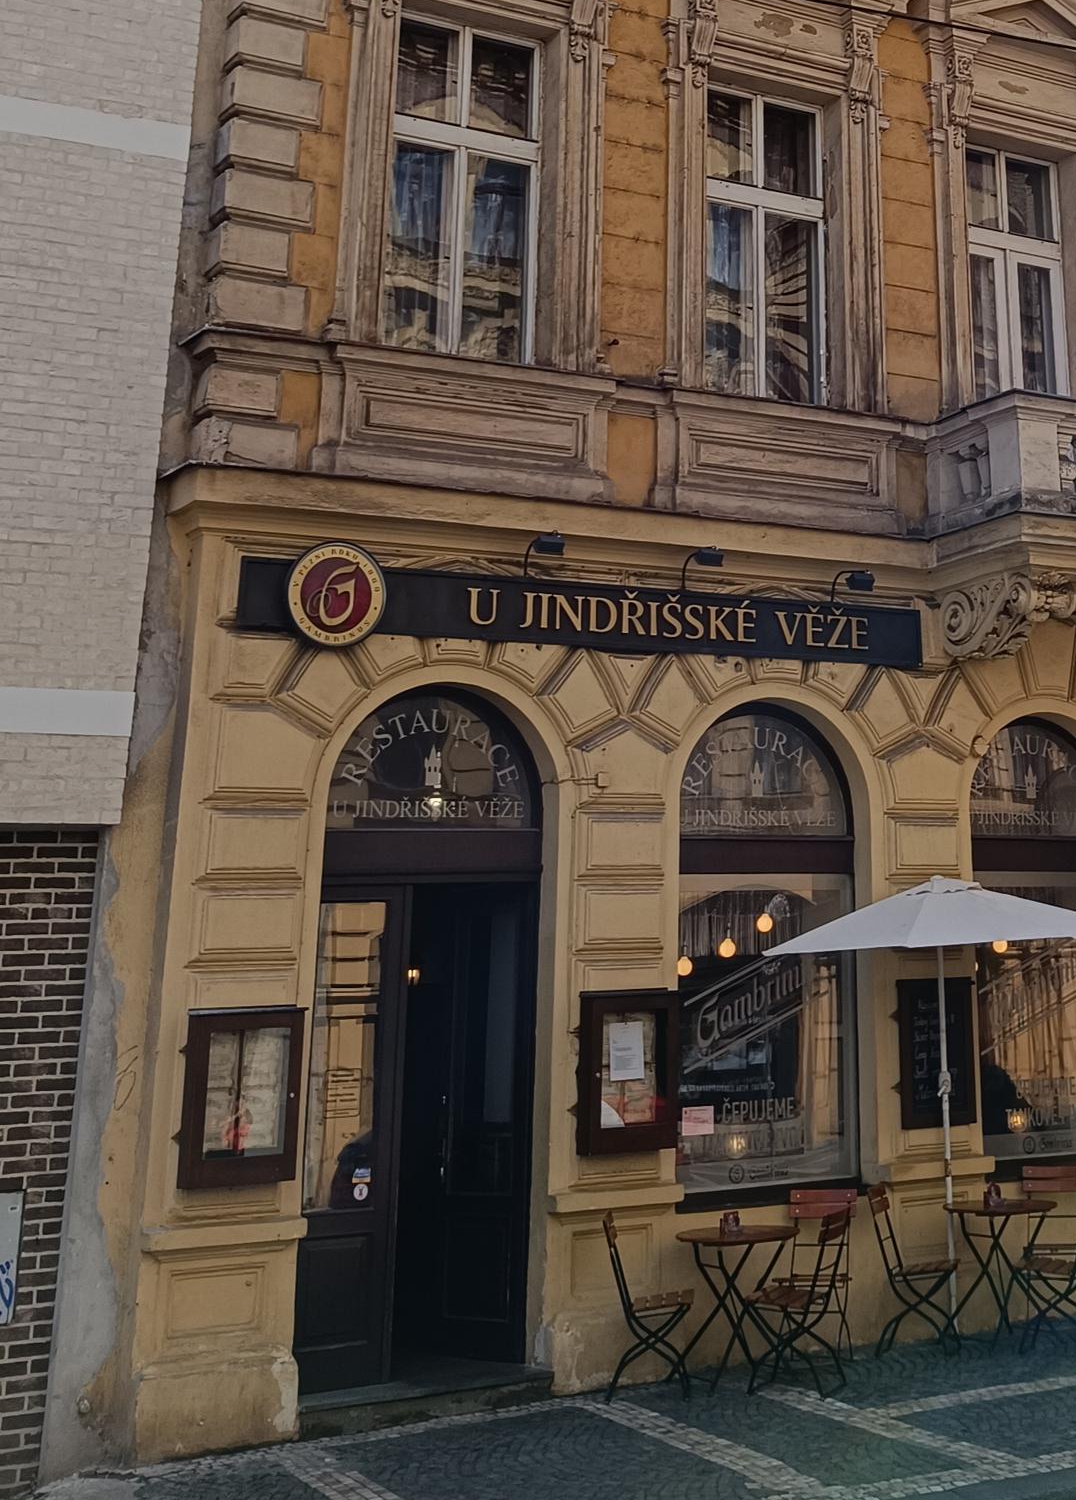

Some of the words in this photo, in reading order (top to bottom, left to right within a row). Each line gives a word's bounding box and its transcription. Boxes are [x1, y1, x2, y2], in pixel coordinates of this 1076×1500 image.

[298, 616, 372, 643] GAMBRINUS
[466, 587, 501, 626] U
[519, 589, 758, 643] JINDŘIŠSKÉ
[774, 604, 870, 651] VĚŽE
[341, 708, 520, 788] RESTAURACE
[332, 799, 349, 819] U
[352, 796, 469, 819] JINDŘIŠSKÉ
[474, 797, 525, 819] VĚŽE
[722, 1097, 795, 1124] ČEPUJEME
